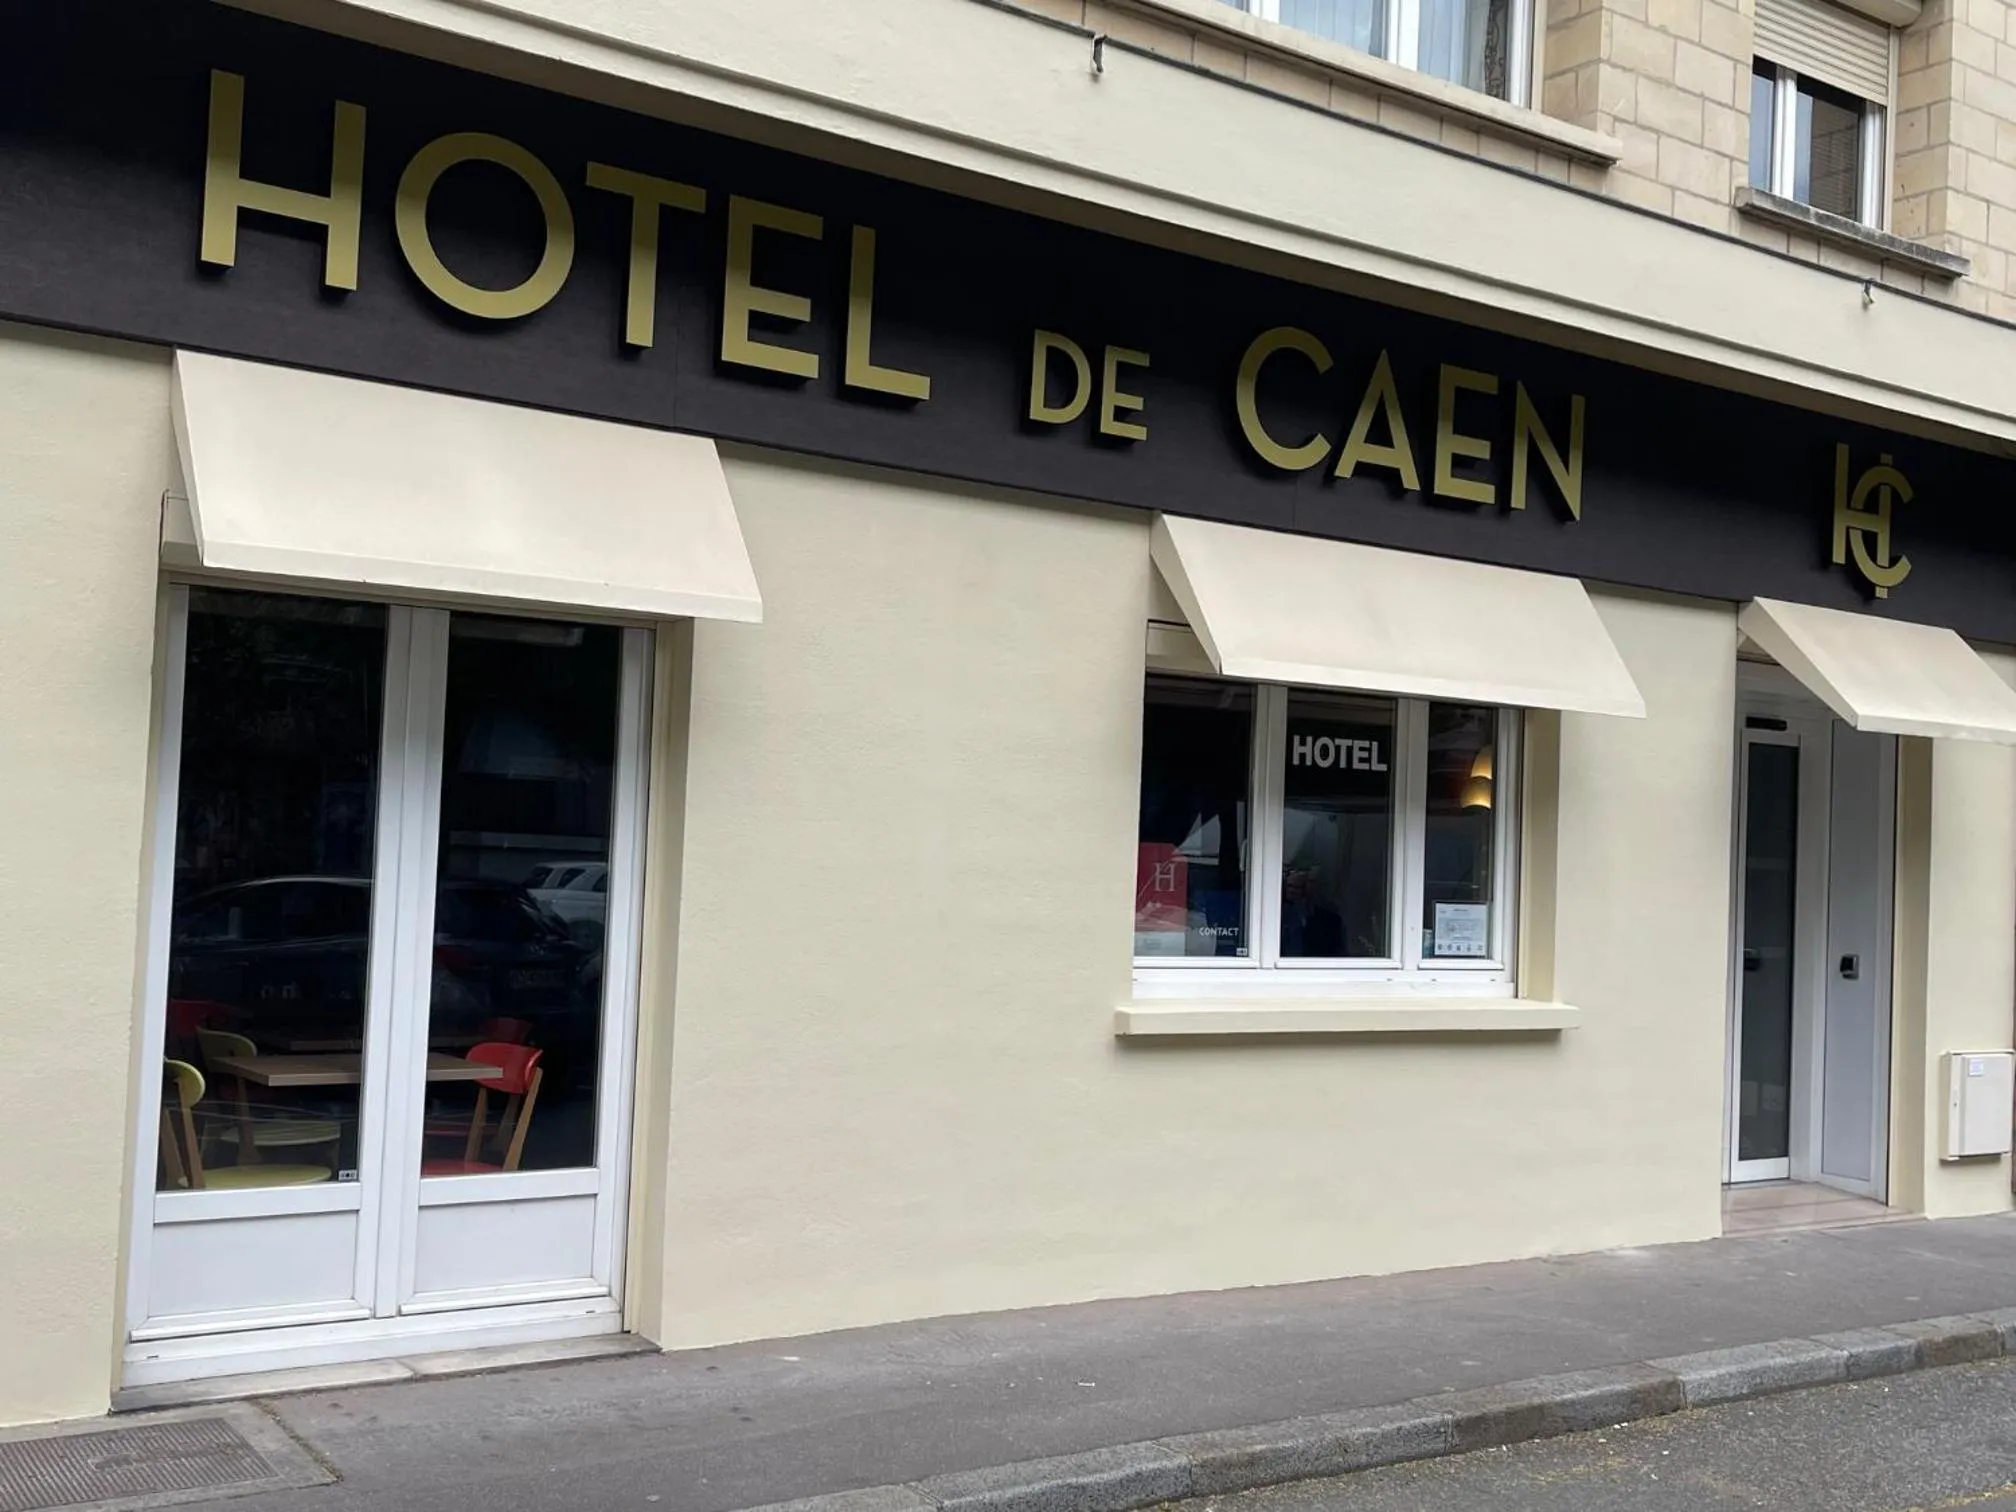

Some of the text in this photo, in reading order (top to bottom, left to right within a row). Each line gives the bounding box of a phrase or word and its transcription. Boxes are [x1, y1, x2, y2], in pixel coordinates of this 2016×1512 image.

[200, 70, 1586, 521] HOTEL DE CAEN
[1292, 735, 1388, 771] HOTEL
[1198, 926, 1240, 937] CONTACT
